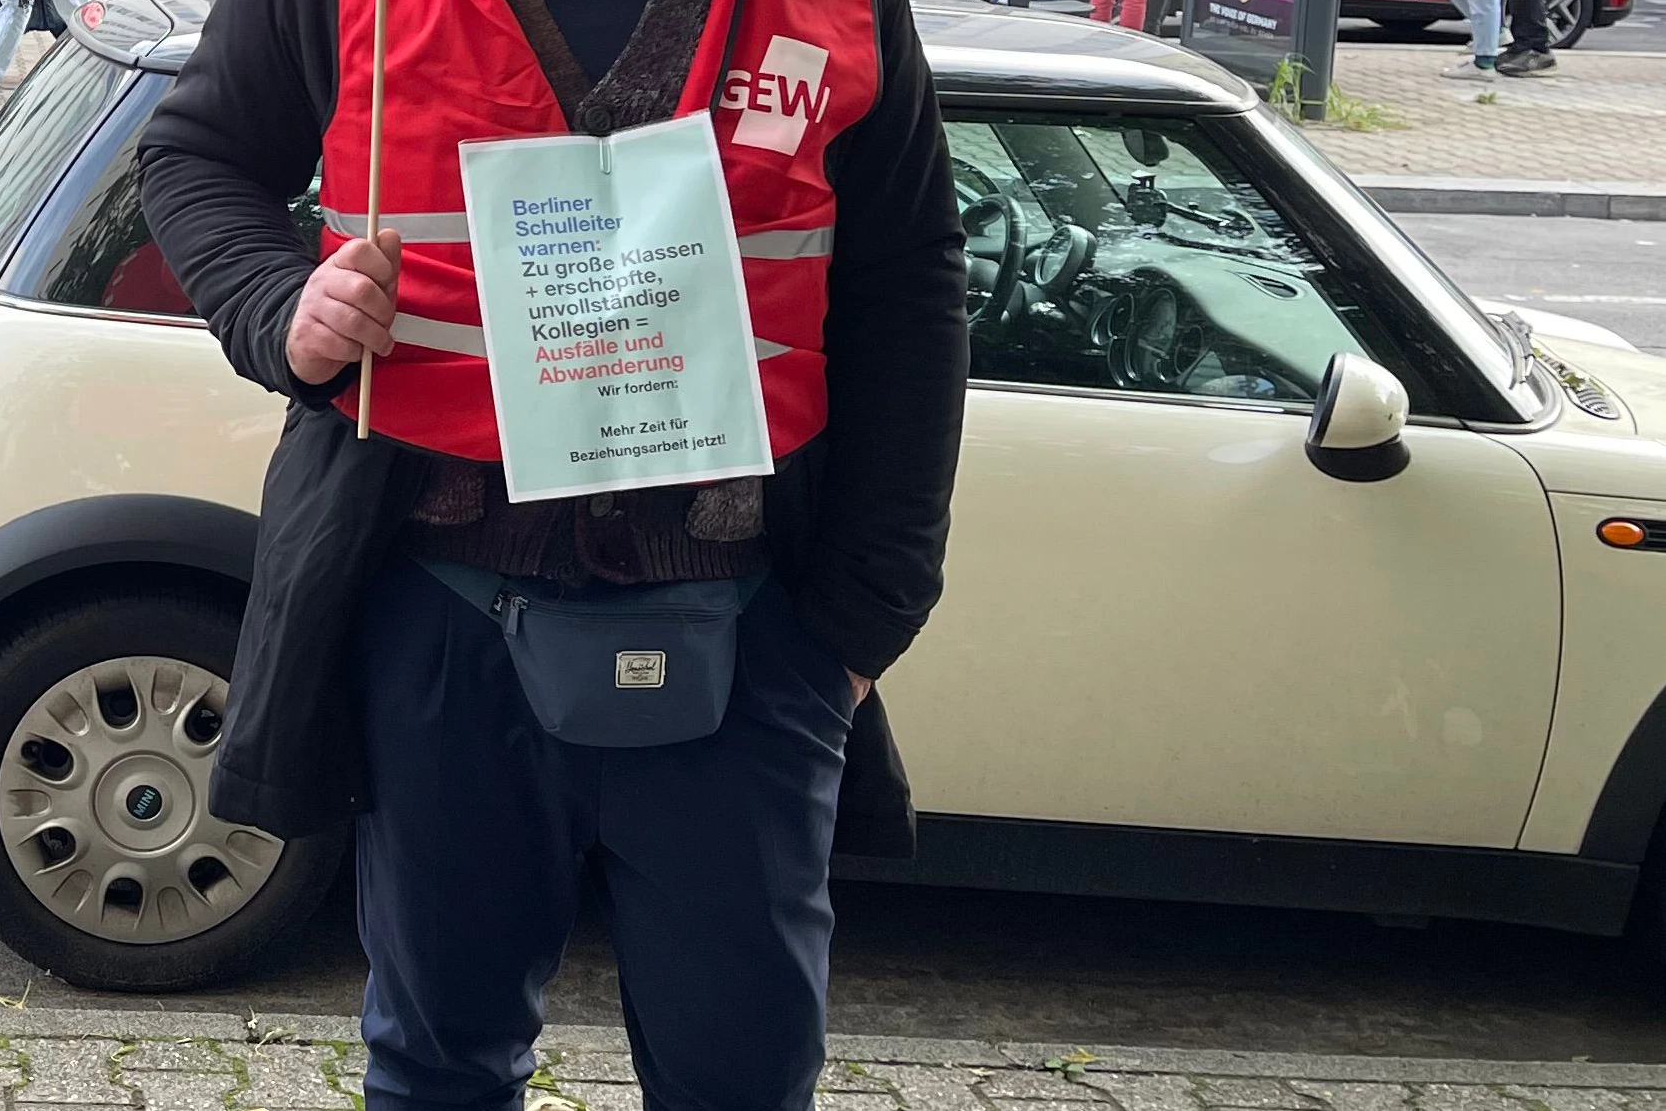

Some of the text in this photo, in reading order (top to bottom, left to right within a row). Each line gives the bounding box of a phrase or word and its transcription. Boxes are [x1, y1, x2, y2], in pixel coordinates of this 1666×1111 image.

[718, 69, 830, 124] GEW
[512, 196, 593, 216] Berliner
[515, 214, 623, 237] Schulleiter
[518, 239, 602, 257] warnen:
[522, 242, 704, 279] Zu große Klassen
[545, 270, 663, 297] erschöpfte,
[529, 289, 680, 320] unvollständige
[532, 316, 630, 342] Kollegien
[535, 331, 664, 364] Ausfälle und
[539, 354, 684, 385] Abwanderung
[598, 379, 678, 397] Wir fordern:
[600, 418, 689, 438] Mehr Zeit für
[570, 433, 726, 463] Beziehungsarbeit jetzt!
[134, 788, 155, 817] MINI
